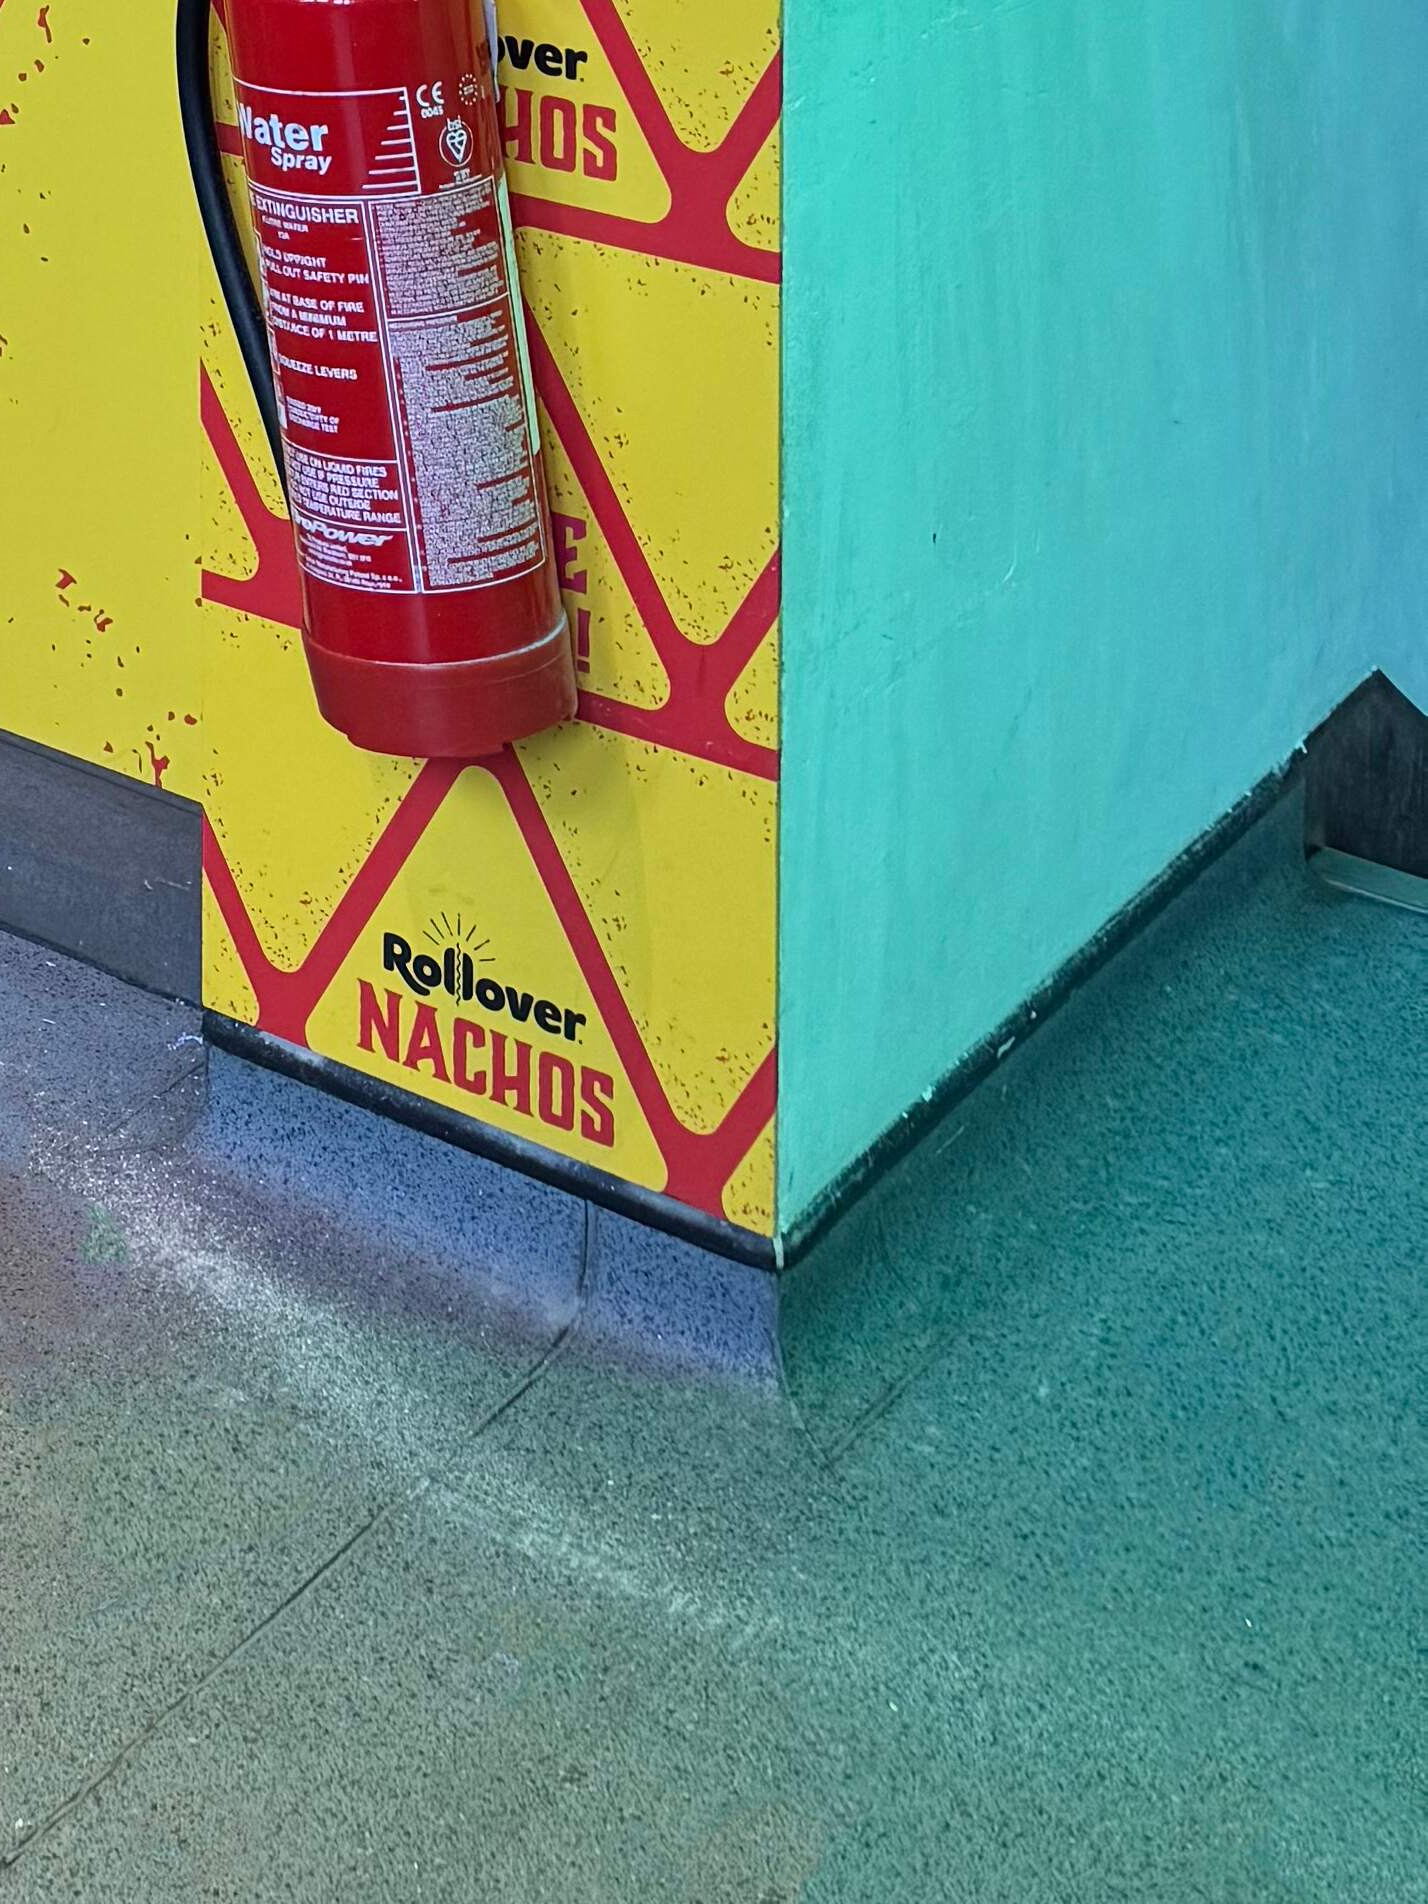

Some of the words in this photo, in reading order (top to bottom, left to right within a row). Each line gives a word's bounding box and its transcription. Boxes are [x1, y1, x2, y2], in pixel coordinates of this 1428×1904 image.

[271, 146, 332, 176] Spray
[255, 194, 360, 224] EXTINGUISHER
[283, 252, 326, 269] UPRIGHT
[283, 265, 301, 279] OUT
[303, 269, 346, 284] SAFETY
[347, 272, 370, 285] PIN
[292, 295, 318, 310] BASE
[320, 300, 335, 311] OF
[337, 301, 365, 313] FIRE
[311, 328, 326, 339] OF
[328, 330, 334, 341] 1
[337, 330, 379, 343] METRE
[314, 365, 358, 381] LEVERS
[323, 460, 354, 474] LIQUID
[355, 465, 387, 478] FIRES
[326, 472, 380, 489] PRESSURE
[351, 487, 399, 501] SECTION
[329, 495, 371, 511] OUTSIDE
[363, 511, 402, 524] RANGE
[382, 931, 587, 1042] Rollover
[356, 978, 615, 1149] NACHOS
